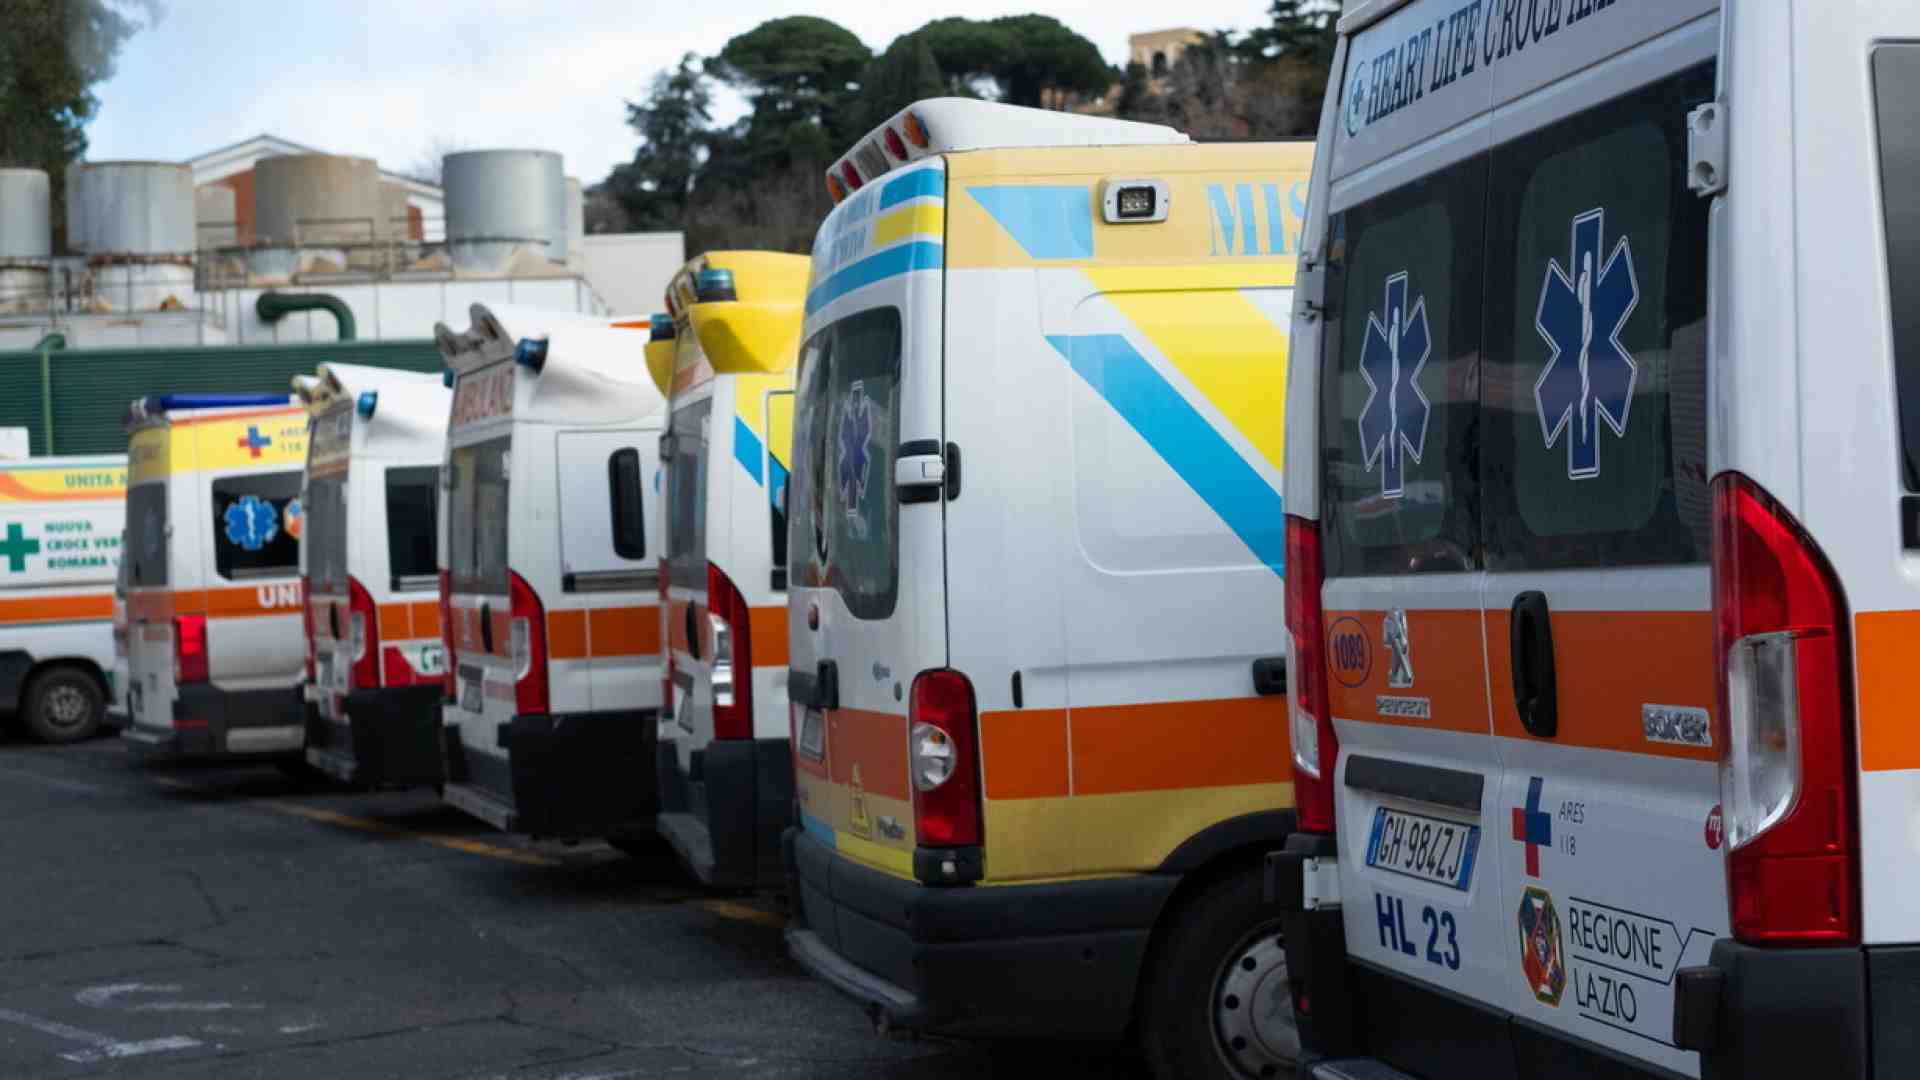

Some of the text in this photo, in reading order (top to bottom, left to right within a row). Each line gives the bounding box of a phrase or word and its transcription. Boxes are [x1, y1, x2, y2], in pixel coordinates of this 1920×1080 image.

[1365, 27, 1432, 125] HEART
[1430, 1, 1480, 92] LIFE
[1335, 634, 1365, 672] 1089
[1558, 802, 1585, 824] ARES
[1560, 836, 1577, 856] 118
[1376, 893, 1460, 971] HL 23
[1569, 908, 1664, 970] REGIONE
[1574, 968, 1637, 1023] LAZIO
